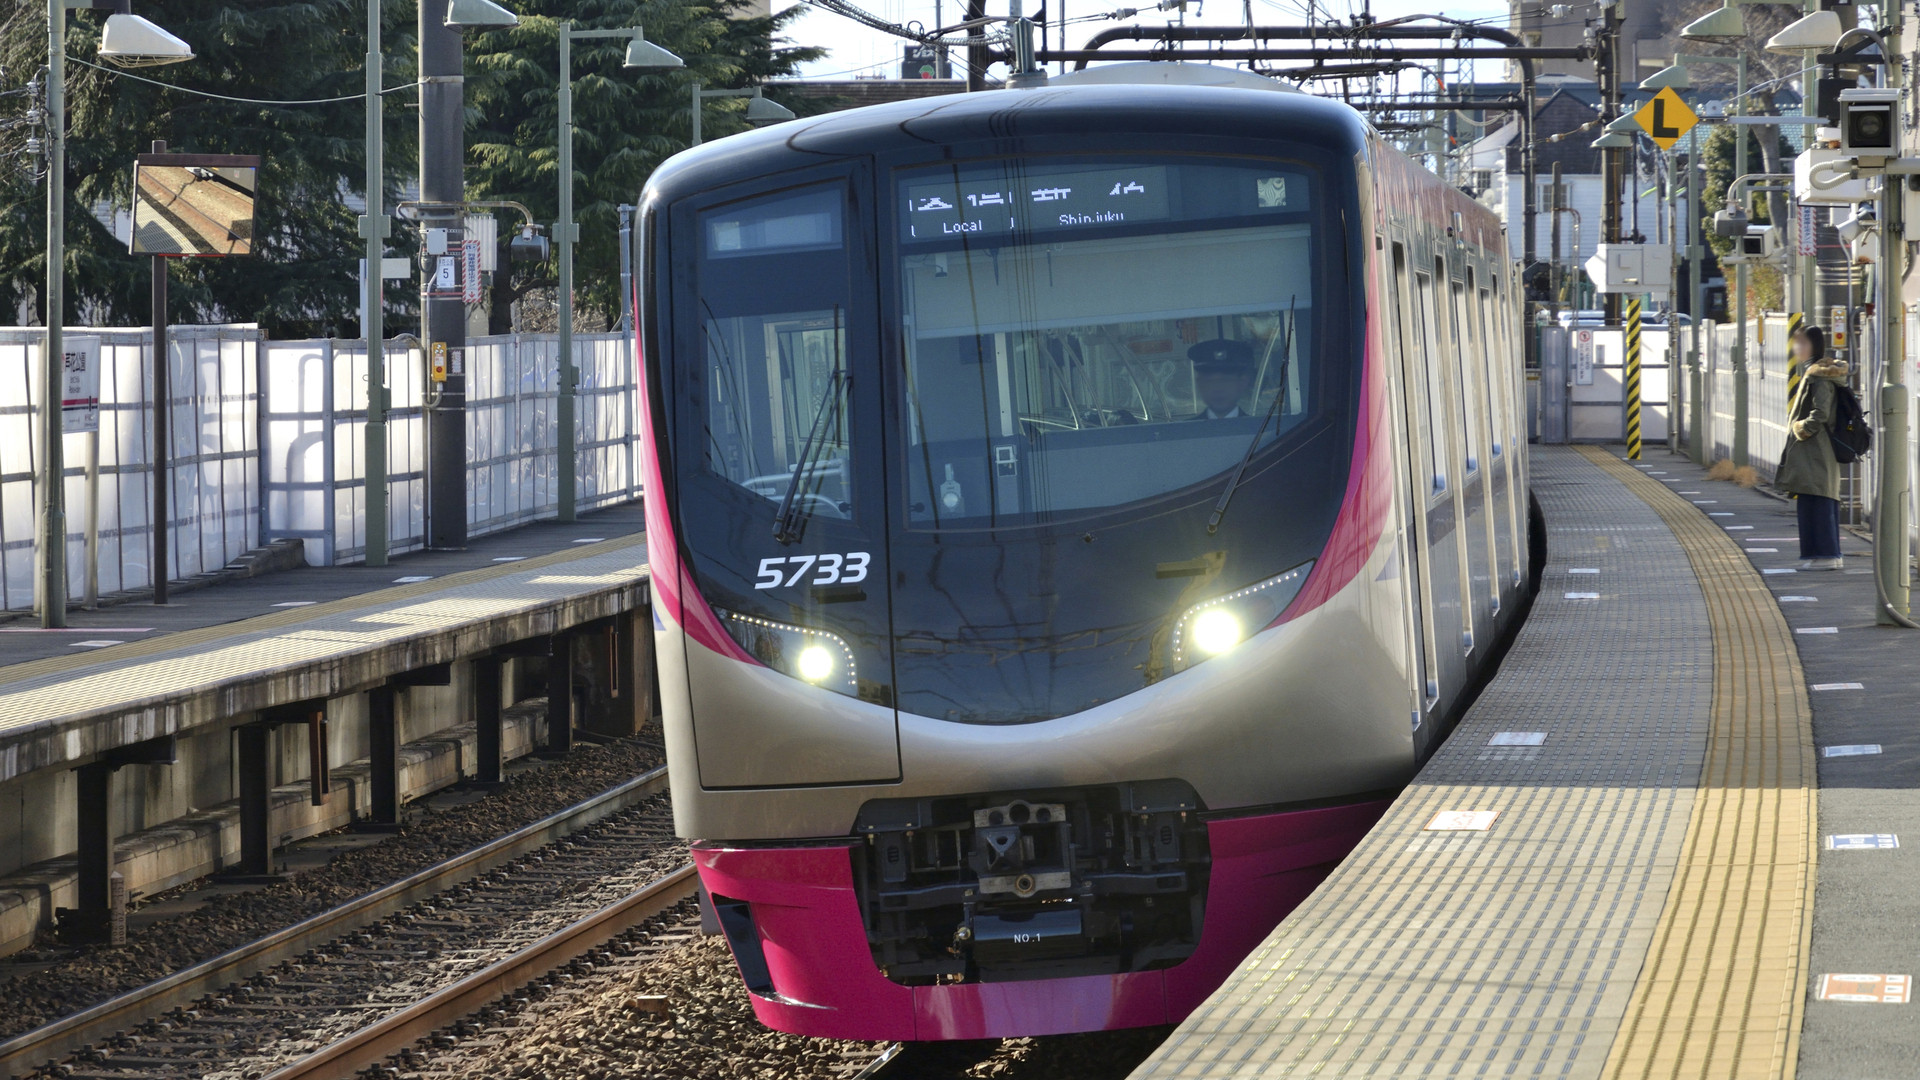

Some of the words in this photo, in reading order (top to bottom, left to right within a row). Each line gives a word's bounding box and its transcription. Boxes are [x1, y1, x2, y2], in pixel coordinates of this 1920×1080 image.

[1653, 98, 1679, 138] L
[943, 219, 983, 234] Local
[442, 268, 449, 279] 5
[754, 551, 871, 590] 5733
[1013, 933, 1041, 943] NO.1
